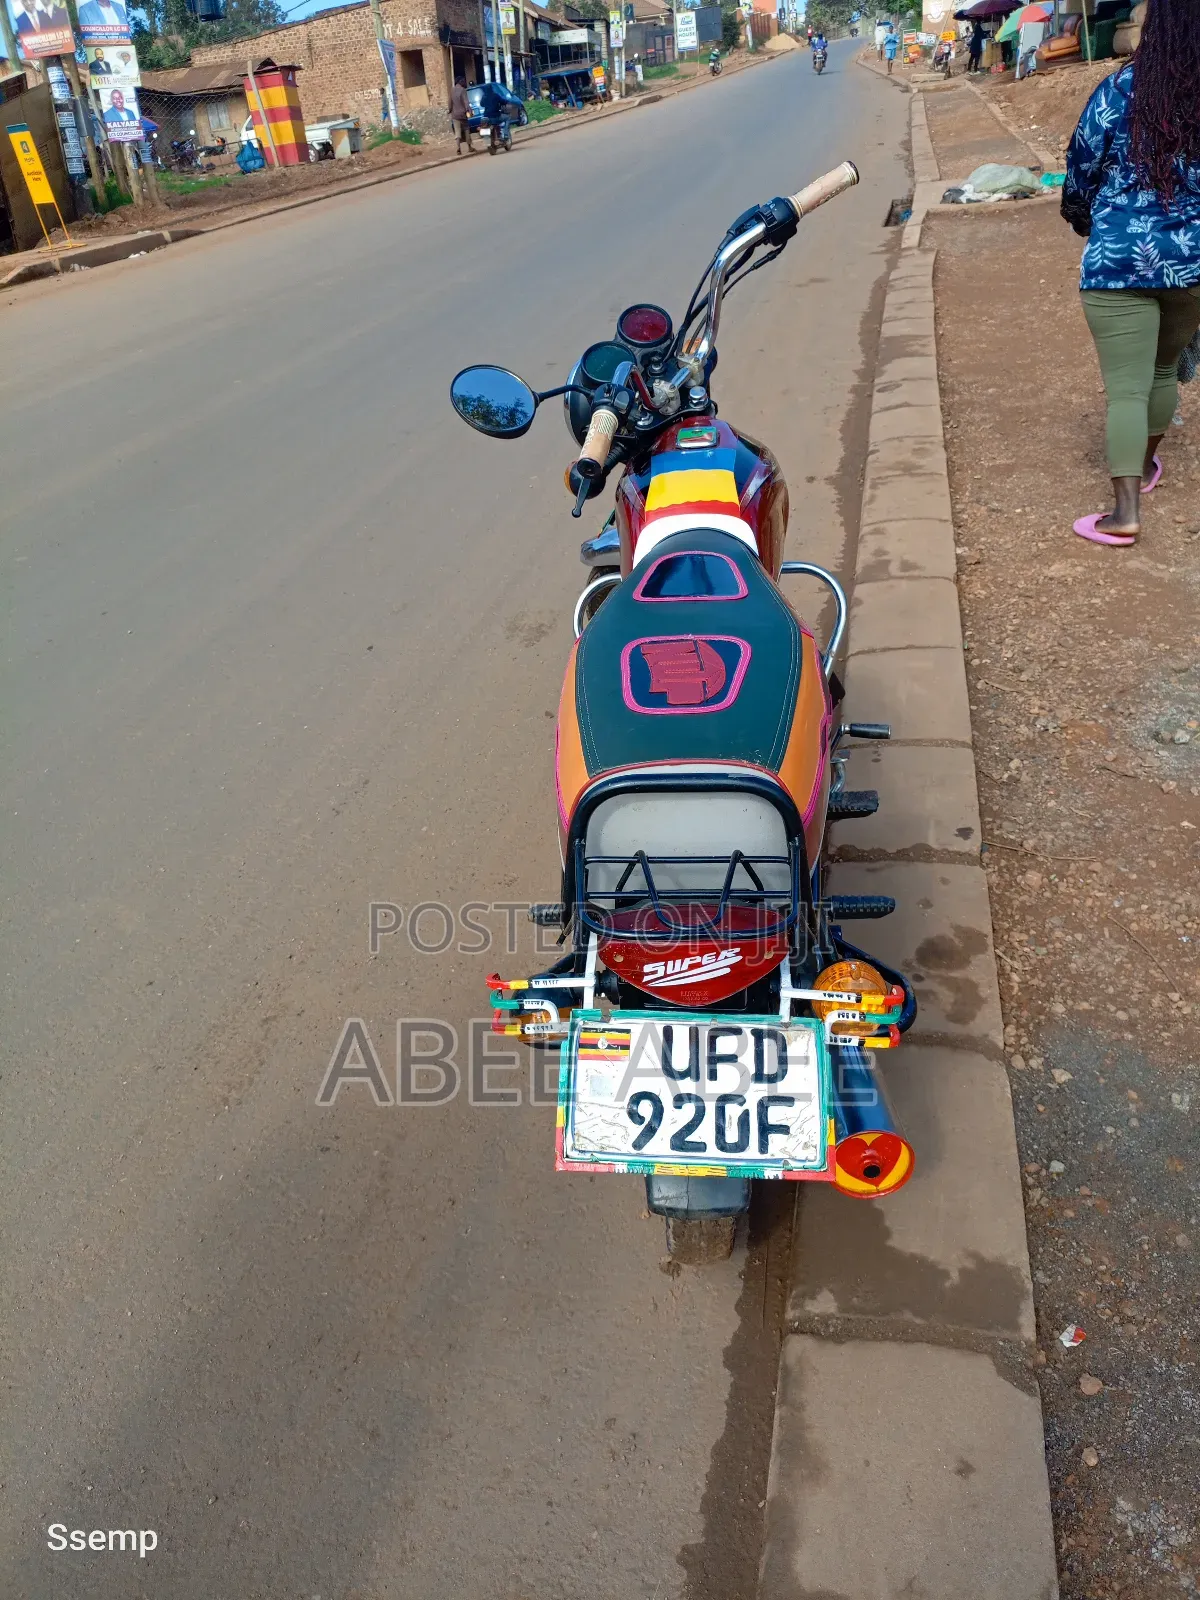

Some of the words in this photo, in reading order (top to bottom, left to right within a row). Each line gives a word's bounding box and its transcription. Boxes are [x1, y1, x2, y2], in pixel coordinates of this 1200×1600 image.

[407, 17, 432, 36] SALE
[93, 76, 112, 85] VOTE
[106, 120, 140, 129] KALYABE
[642, 947, 742, 983] SUPER
[662, 1025, 788, 1084] UFD
[626, 1091, 796, 1154] 920F
